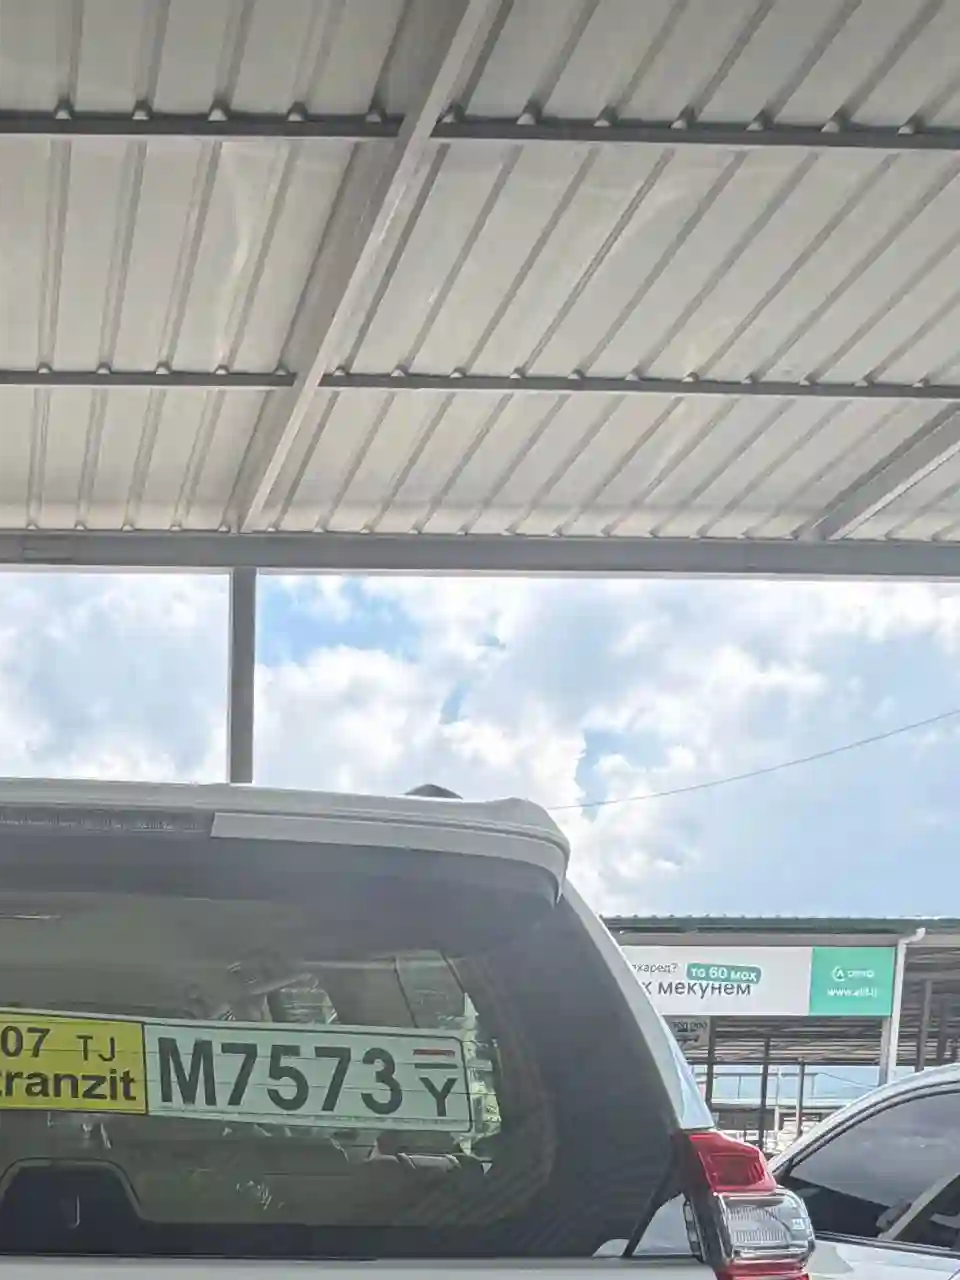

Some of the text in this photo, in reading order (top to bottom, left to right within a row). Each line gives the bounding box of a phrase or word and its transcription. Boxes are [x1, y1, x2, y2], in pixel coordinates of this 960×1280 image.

[657, 981, 752, 999] мекунем
[708, 966, 728, 979] 60
[0, 1025, 116, 1062] 07 TJ
[157, 1036, 403, 1115] M7573
[419, 1076, 458, 1117] Y
